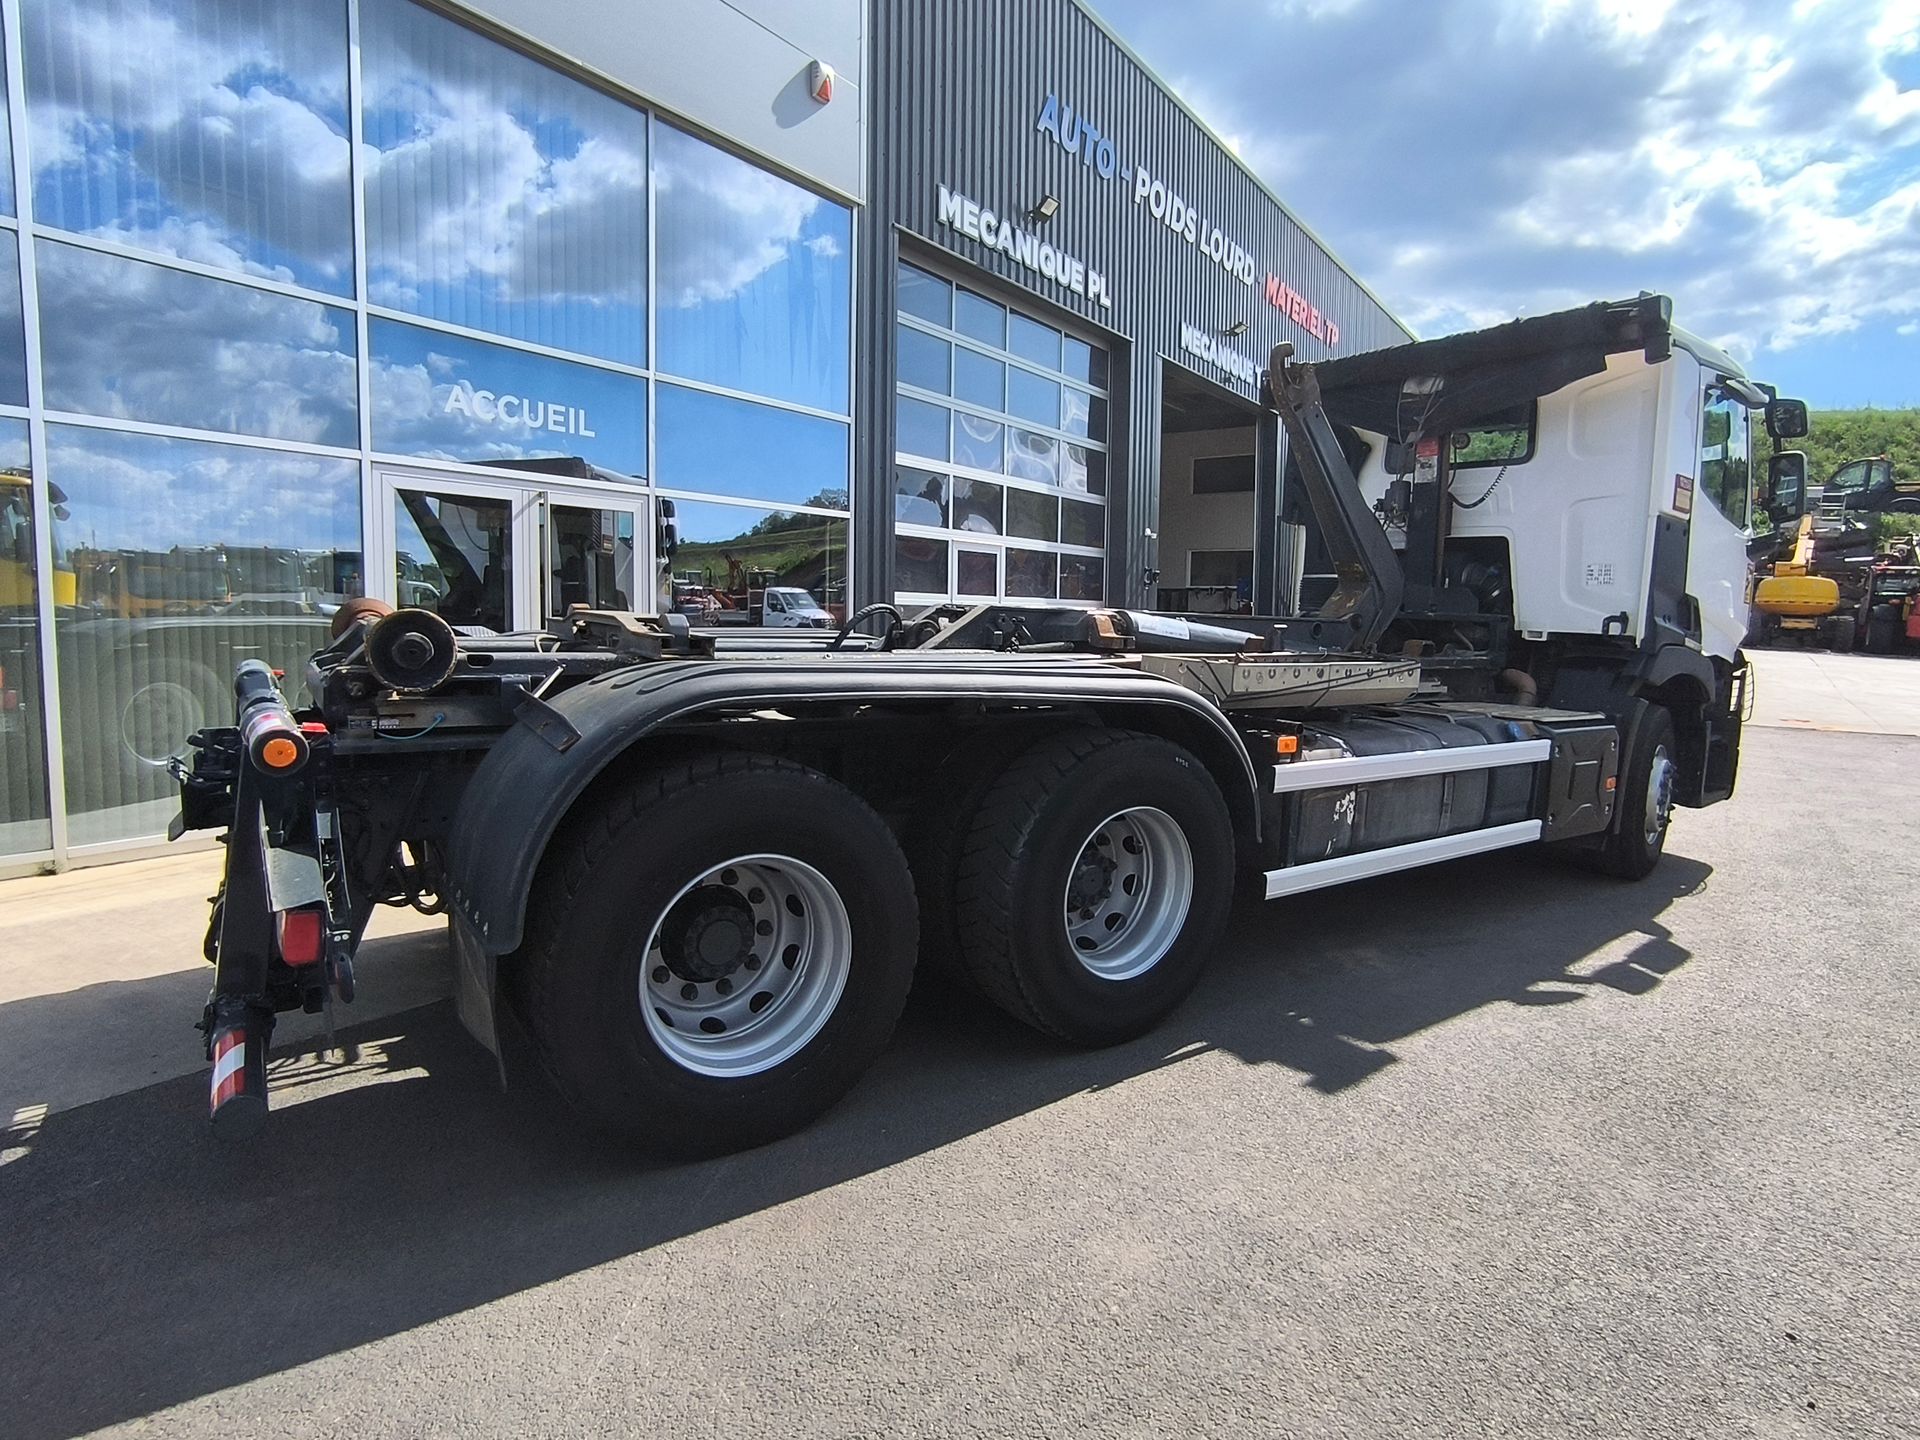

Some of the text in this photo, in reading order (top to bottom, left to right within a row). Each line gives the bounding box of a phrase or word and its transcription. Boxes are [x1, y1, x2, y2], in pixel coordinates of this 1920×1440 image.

[937, 184, 1112, 309] MECANIQUE PL
[1037, 94, 1115, 179] AUTO
[1135, 166, 1197, 243] POIDS
[1200, 218, 1255, 286] LOURD
[1265, 272, 1323, 341] MATERIEL
[1324, 318, 1340, 348] TP
[1181, 321, 1256, 388] MECANIQUE
[444, 385, 596, 438] ACCUEIL
